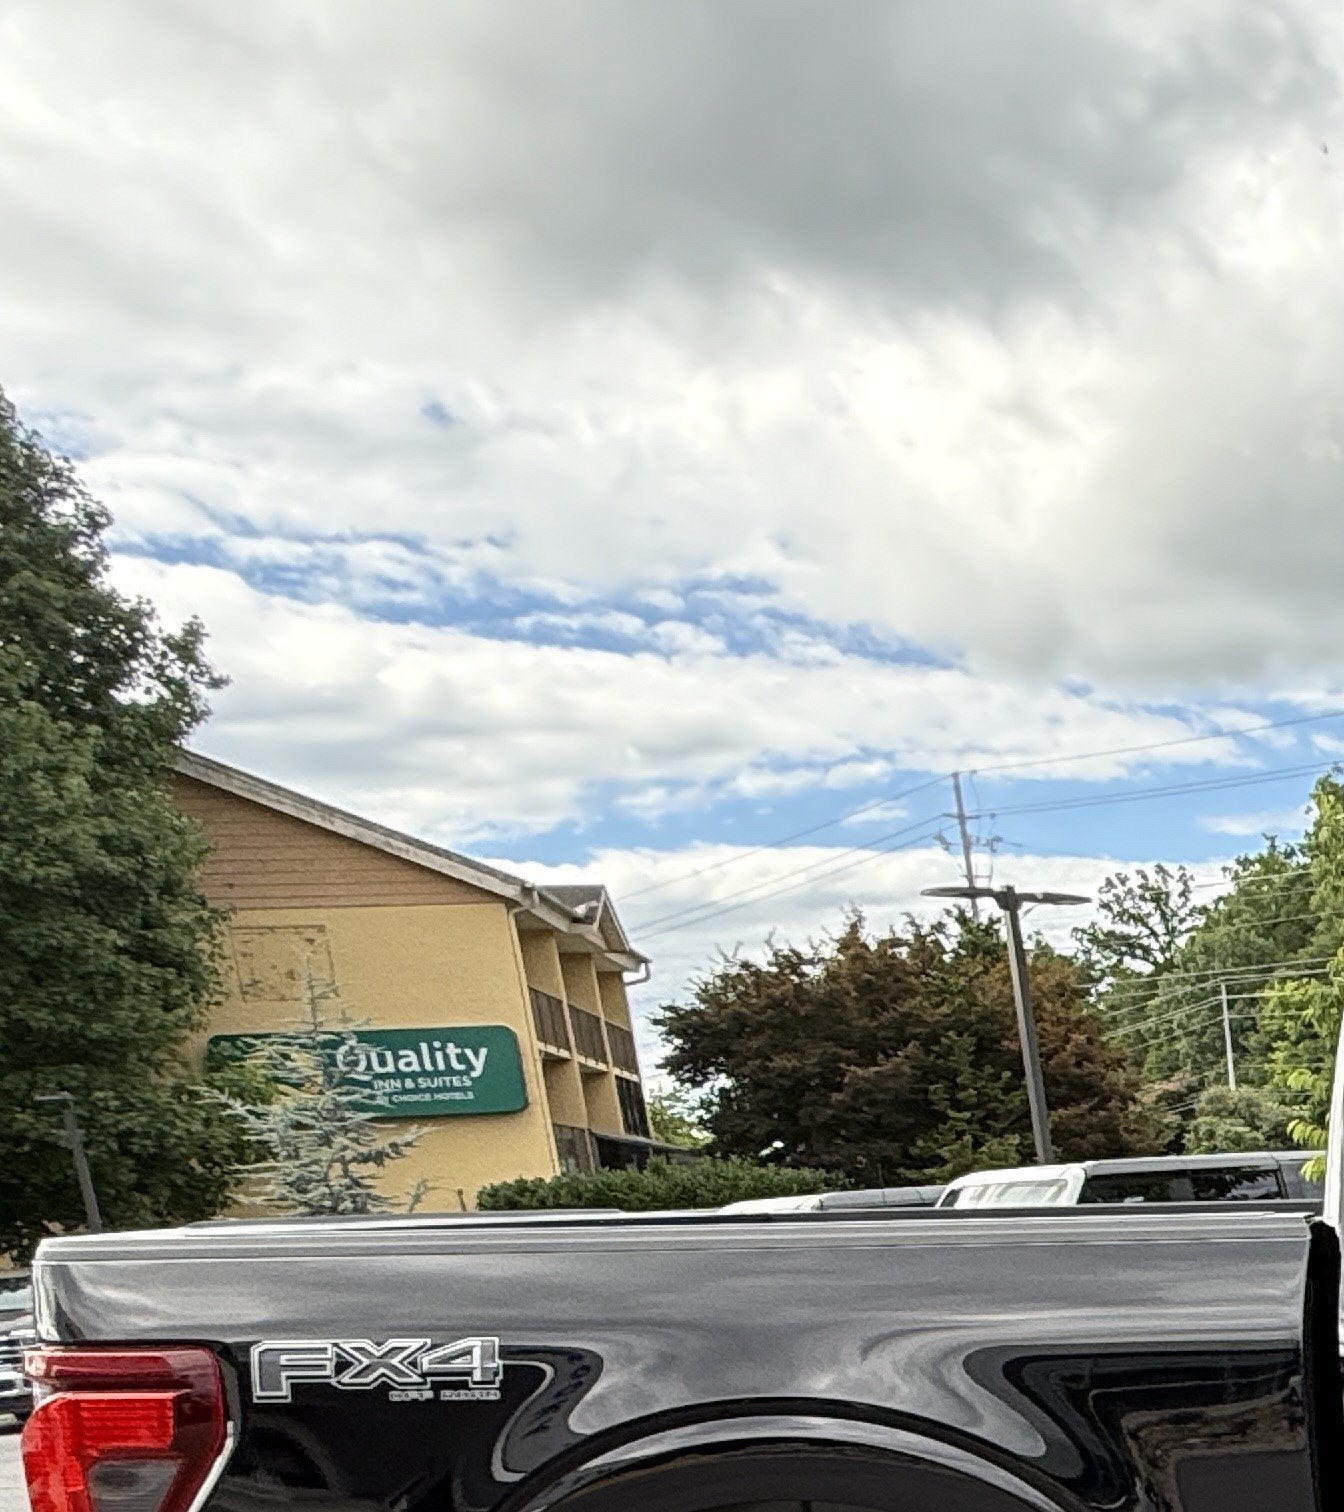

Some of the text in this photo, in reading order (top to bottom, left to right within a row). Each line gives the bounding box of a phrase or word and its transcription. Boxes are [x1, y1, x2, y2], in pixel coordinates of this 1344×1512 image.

[336, 1041, 488, 1082] Quality
[404, 1078, 415, 1089] &
[418, 1075, 472, 1088] SUITES
[252, 1337, 502, 1403] FX4
